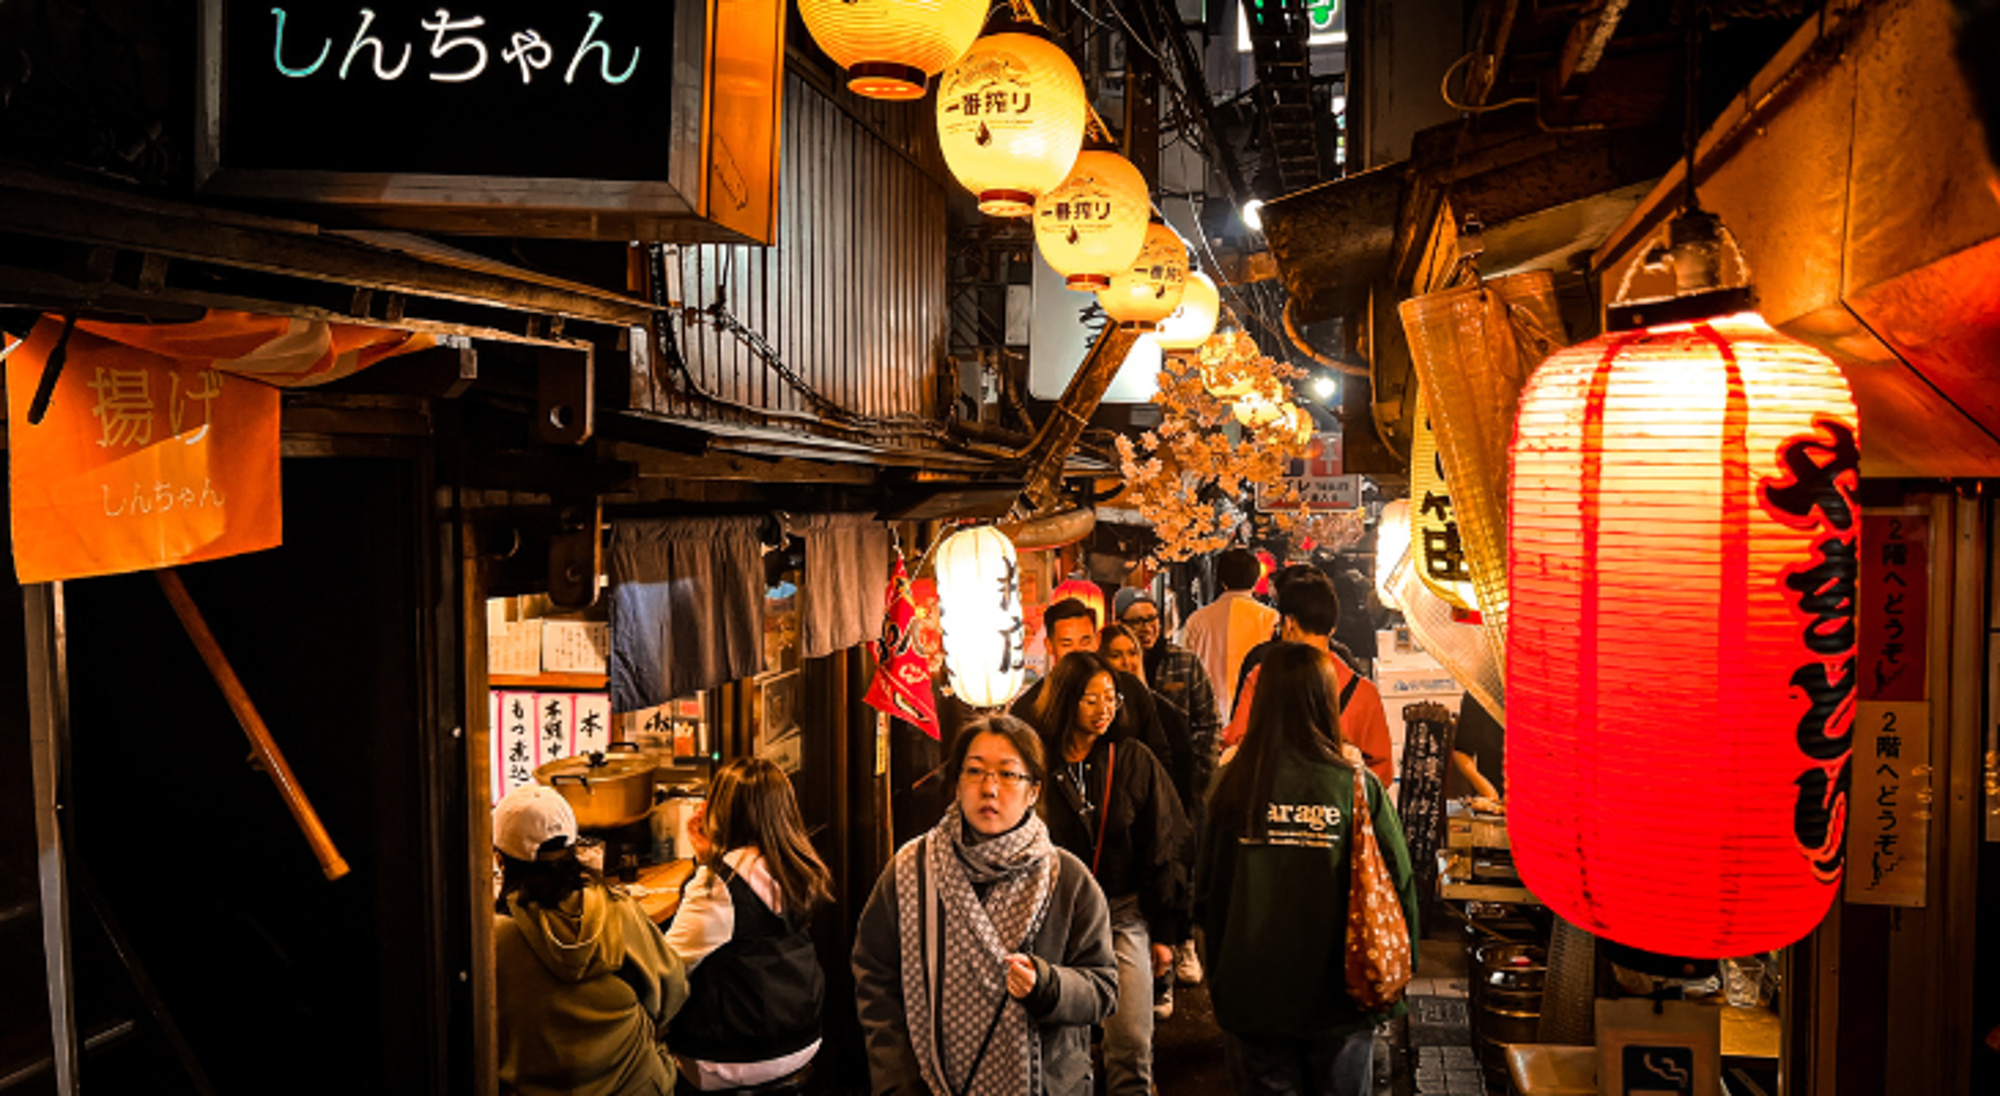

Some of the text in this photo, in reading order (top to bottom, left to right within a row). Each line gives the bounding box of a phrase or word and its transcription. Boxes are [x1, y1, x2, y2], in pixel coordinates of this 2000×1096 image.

[271, 7, 640, 84] しんちゃん
[945, 91, 1031, 116] 一番搾り
[1040, 202, 1111, 221] 一番搾り
[87, 366, 224, 448] 揚げ
[102, 477, 226, 517] しんちゃん
[509, 699, 531, 787] もつ煮込
[1874, 712, 1900, 856] 2階へどうぞ
[1267, 803, 1341, 831] arage
